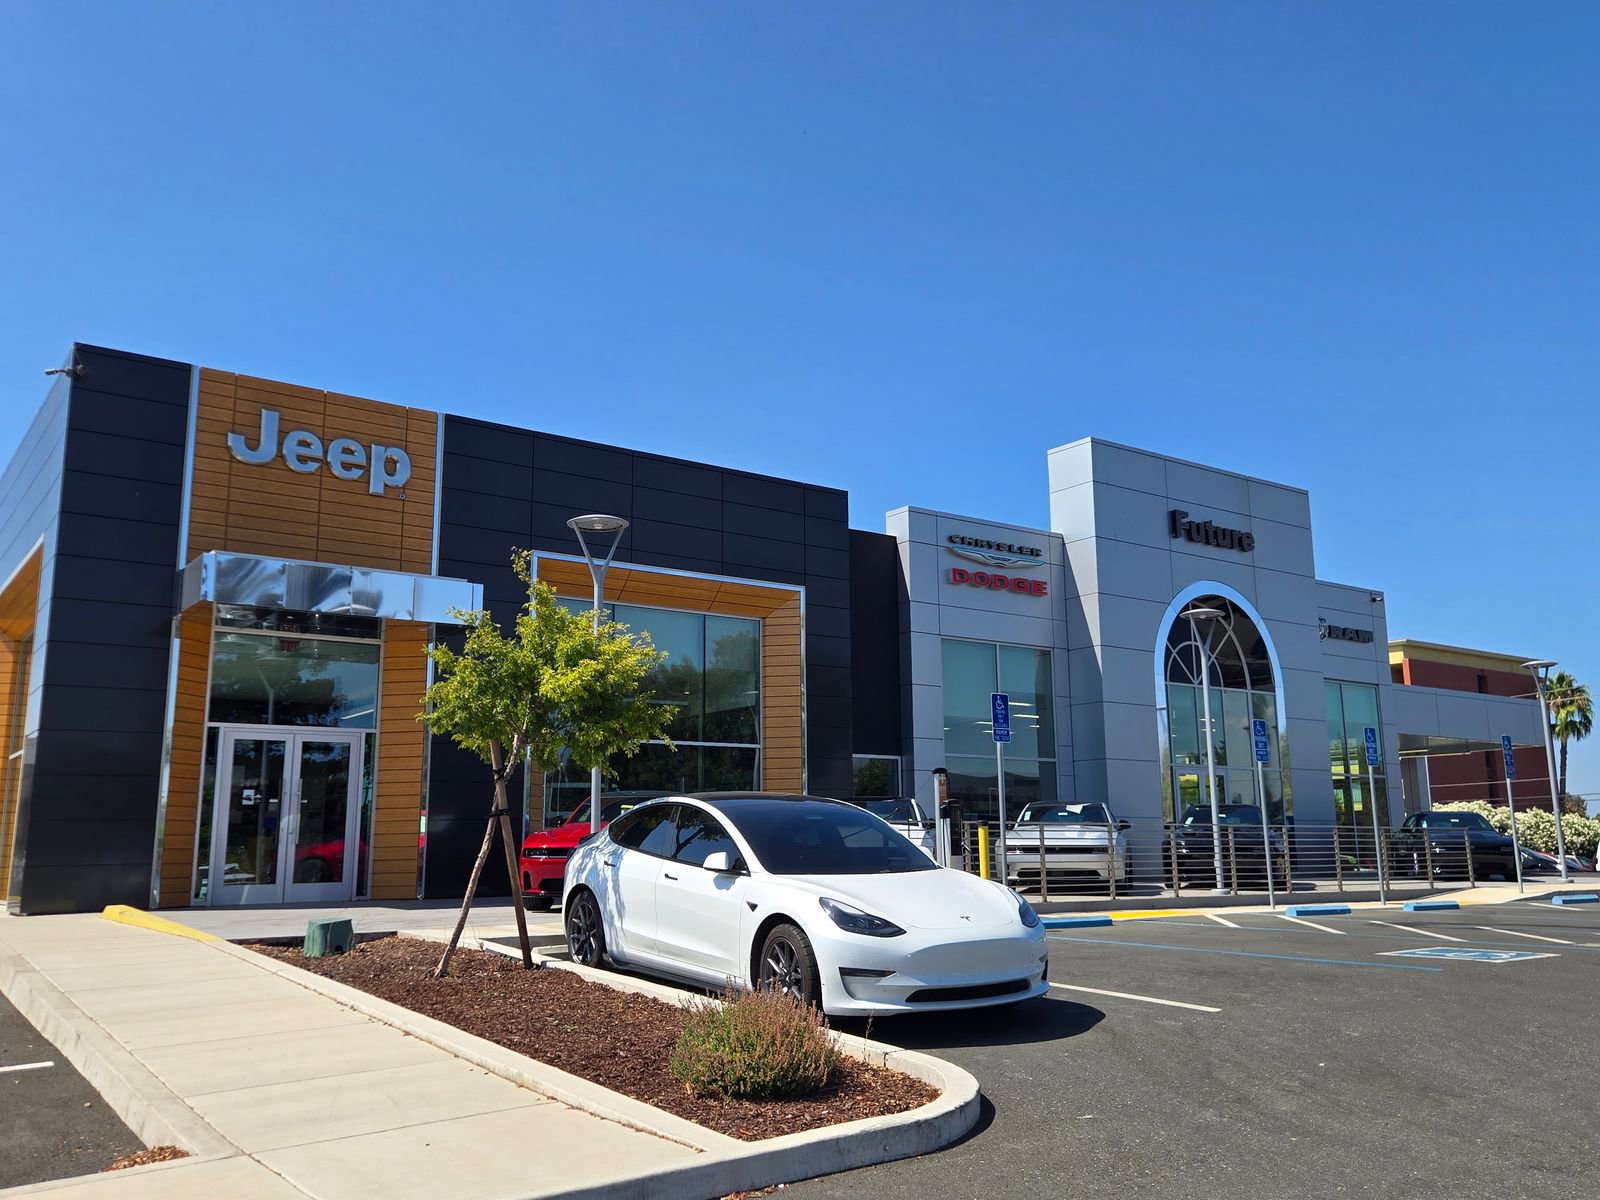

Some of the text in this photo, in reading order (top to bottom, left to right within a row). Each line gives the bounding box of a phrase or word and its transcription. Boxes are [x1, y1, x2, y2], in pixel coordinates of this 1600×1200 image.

[227, 408, 412, 496] Jeep
[947, 534, 1042, 556] CHRYSLER
[1168, 509, 1255, 552] Future
[951, 567, 1048, 596] DODGE
[1328, 625, 1374, 643] RAM
